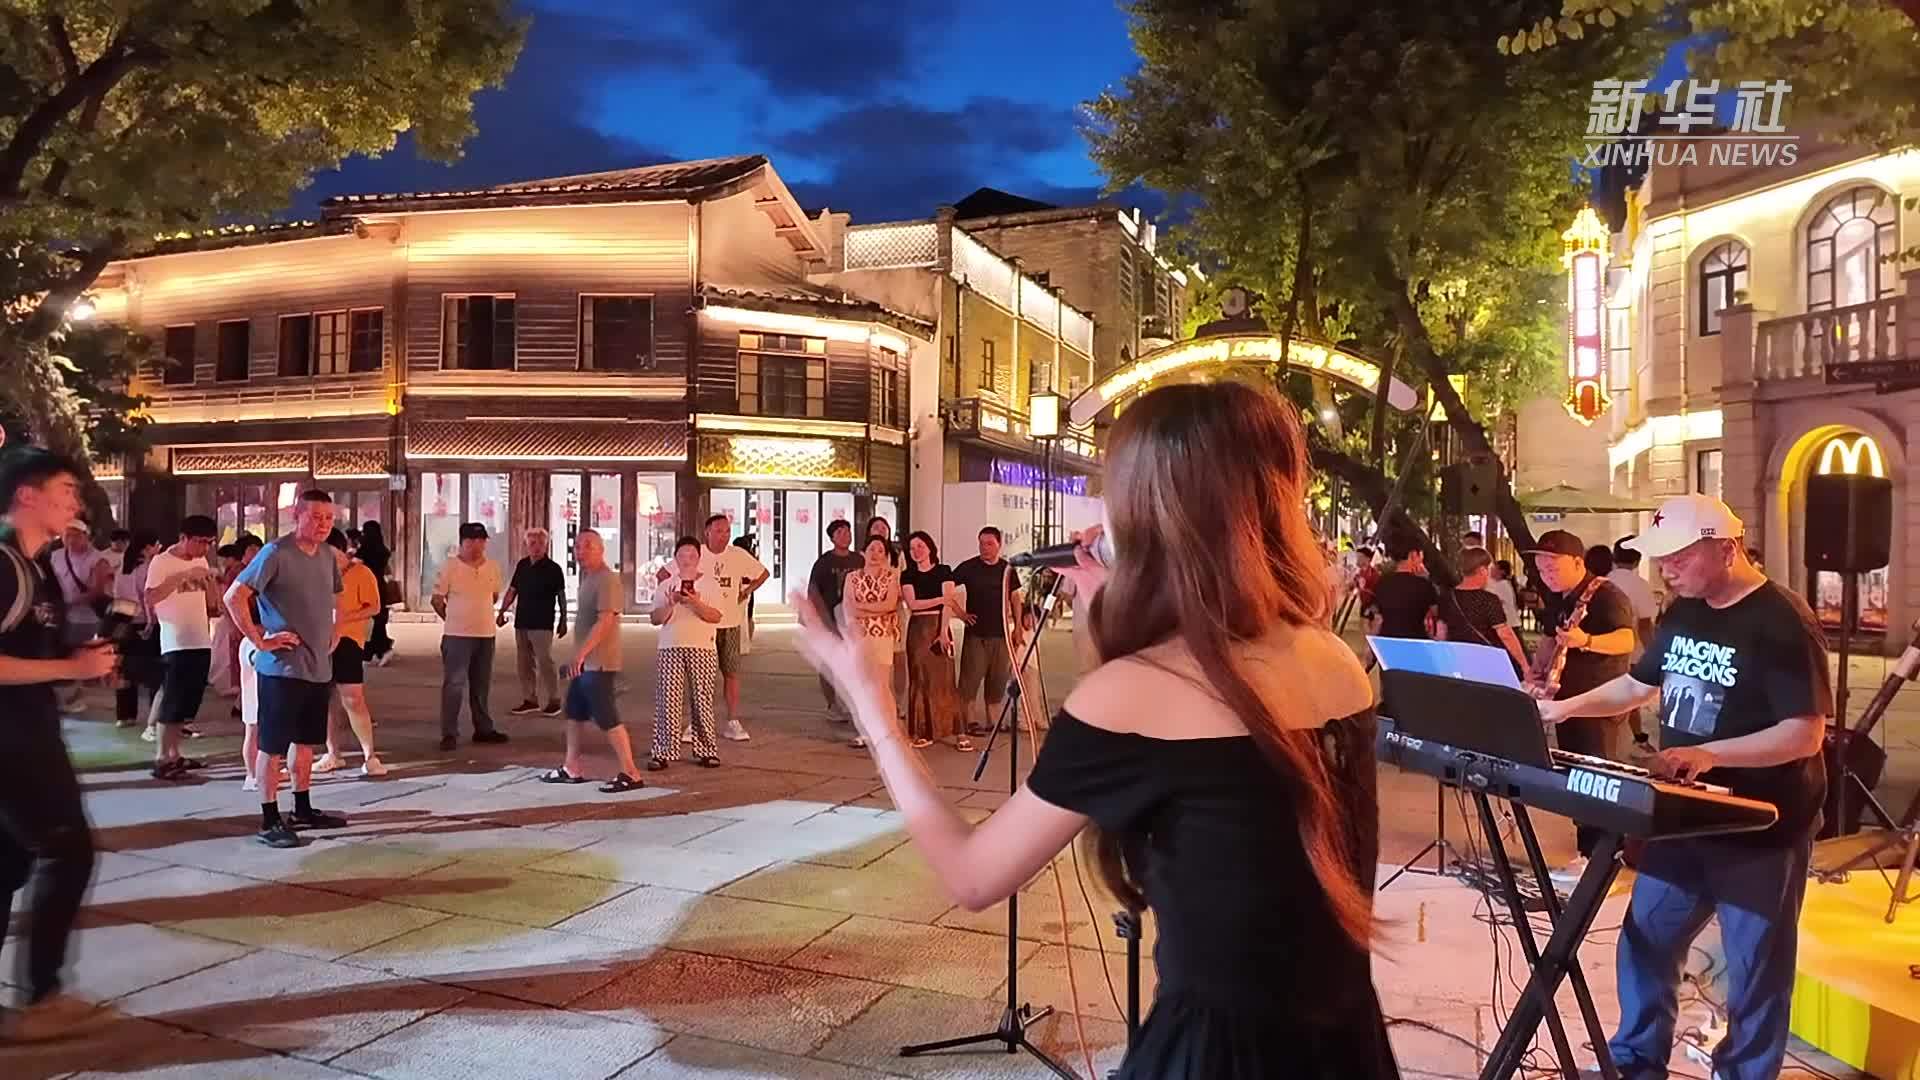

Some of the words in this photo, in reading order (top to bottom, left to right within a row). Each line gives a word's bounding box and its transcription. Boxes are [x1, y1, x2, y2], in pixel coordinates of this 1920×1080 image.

[1671, 636, 1735, 665] IMAGINE
[1662, 653, 1738, 686] DRAGONS
[1566, 769, 1621, 803] KORG
